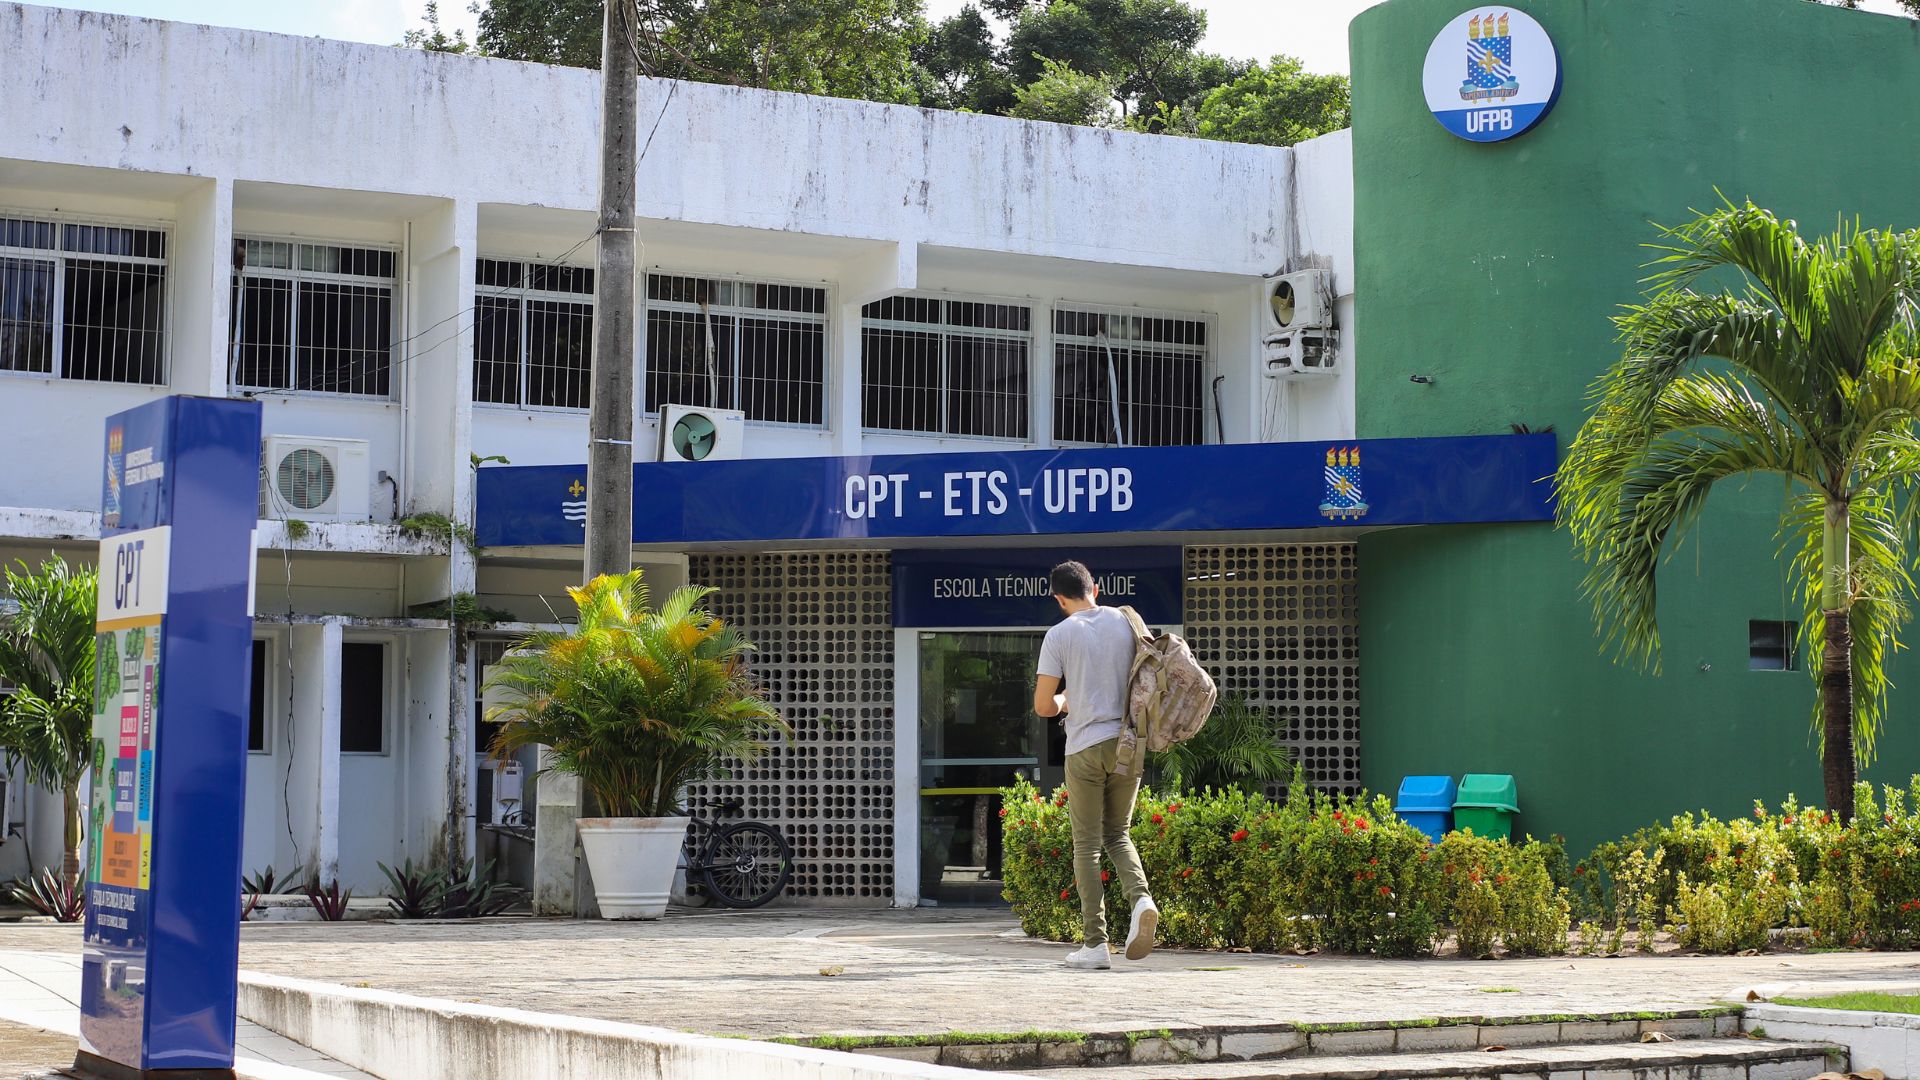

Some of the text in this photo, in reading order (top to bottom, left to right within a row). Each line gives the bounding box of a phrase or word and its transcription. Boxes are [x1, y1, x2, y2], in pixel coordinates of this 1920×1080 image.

[1466, 109, 1513, 133] UFPB
[845, 473, 910, 519] CPT
[944, 470, 1008, 517] ETS
[1044, 467, 1134, 514] UFPB
[115, 540, 144, 610] CPT
[933, 577, 991, 598] ESCOLA
[1091, 571, 1136, 596] AÚDE
